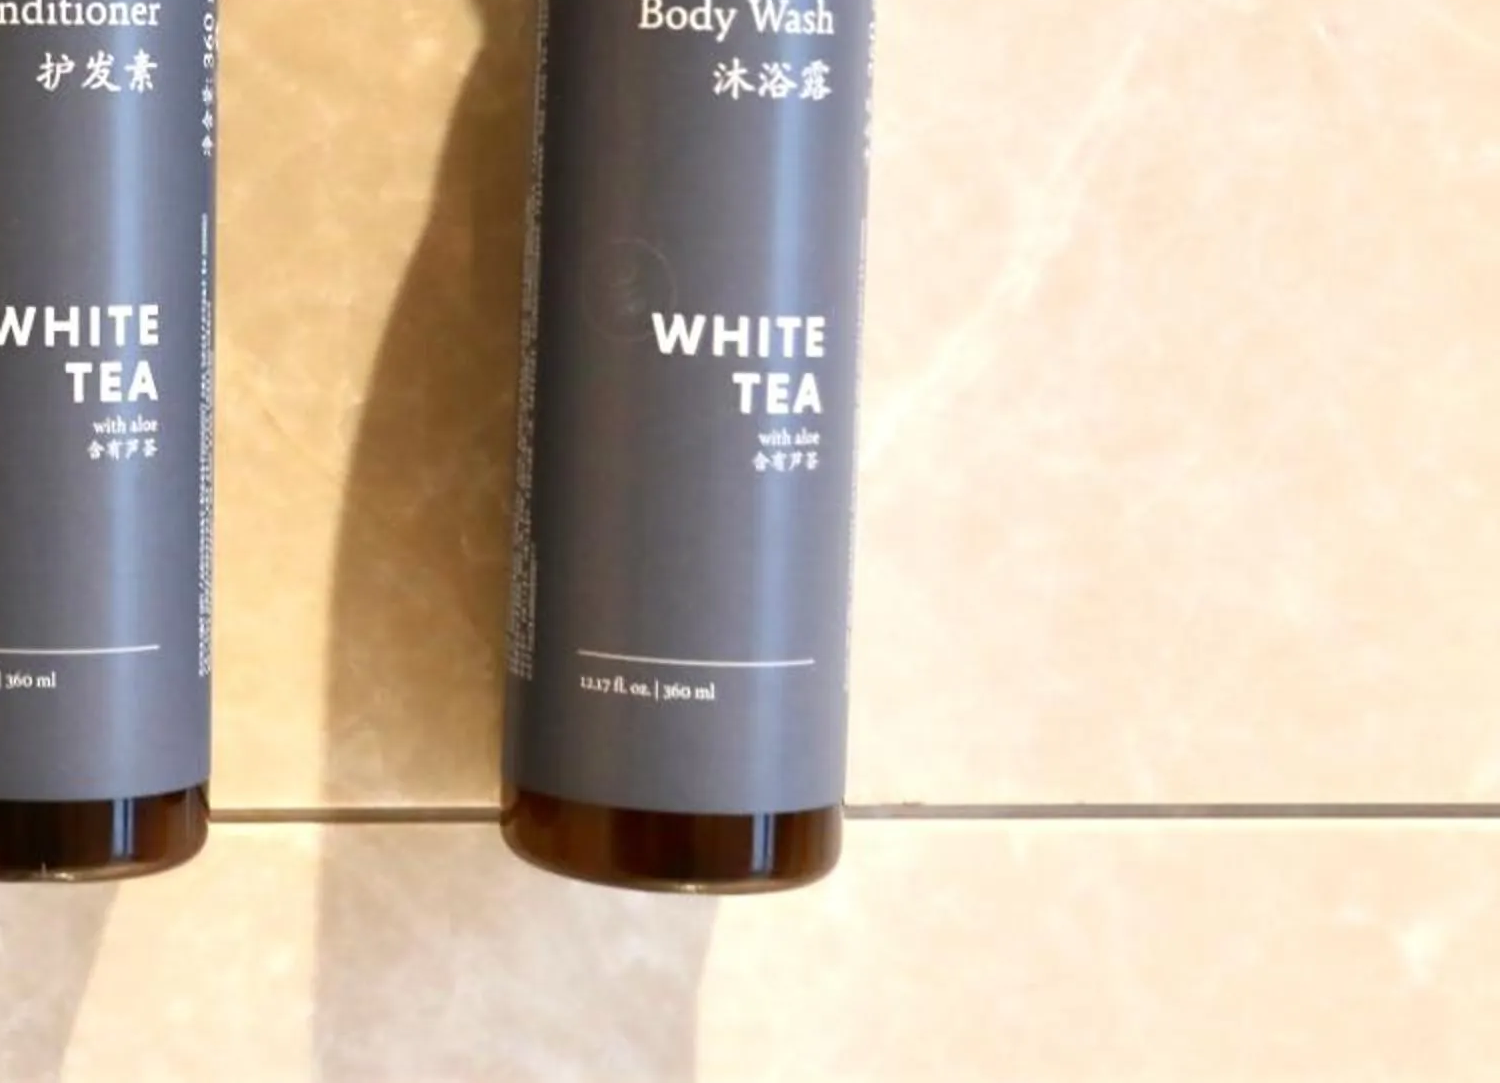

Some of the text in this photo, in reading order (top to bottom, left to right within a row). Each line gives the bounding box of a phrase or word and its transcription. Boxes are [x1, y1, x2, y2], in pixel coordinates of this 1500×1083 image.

[35, 48, 158, 94] 护发素
[712, 57, 833, 101] 沐浴露
[651, 312, 827, 359] WHITE
[65, 360, 160, 404] TEA
[731, 371, 824, 416] TEA
[92, 413, 128, 435] with
[758, 426, 792, 447] with
[4, 670, 34, 690] 360
[36, 669, 57, 689] ml
[662, 681, 692, 702] 360
[694, 681, 716, 701] ml
